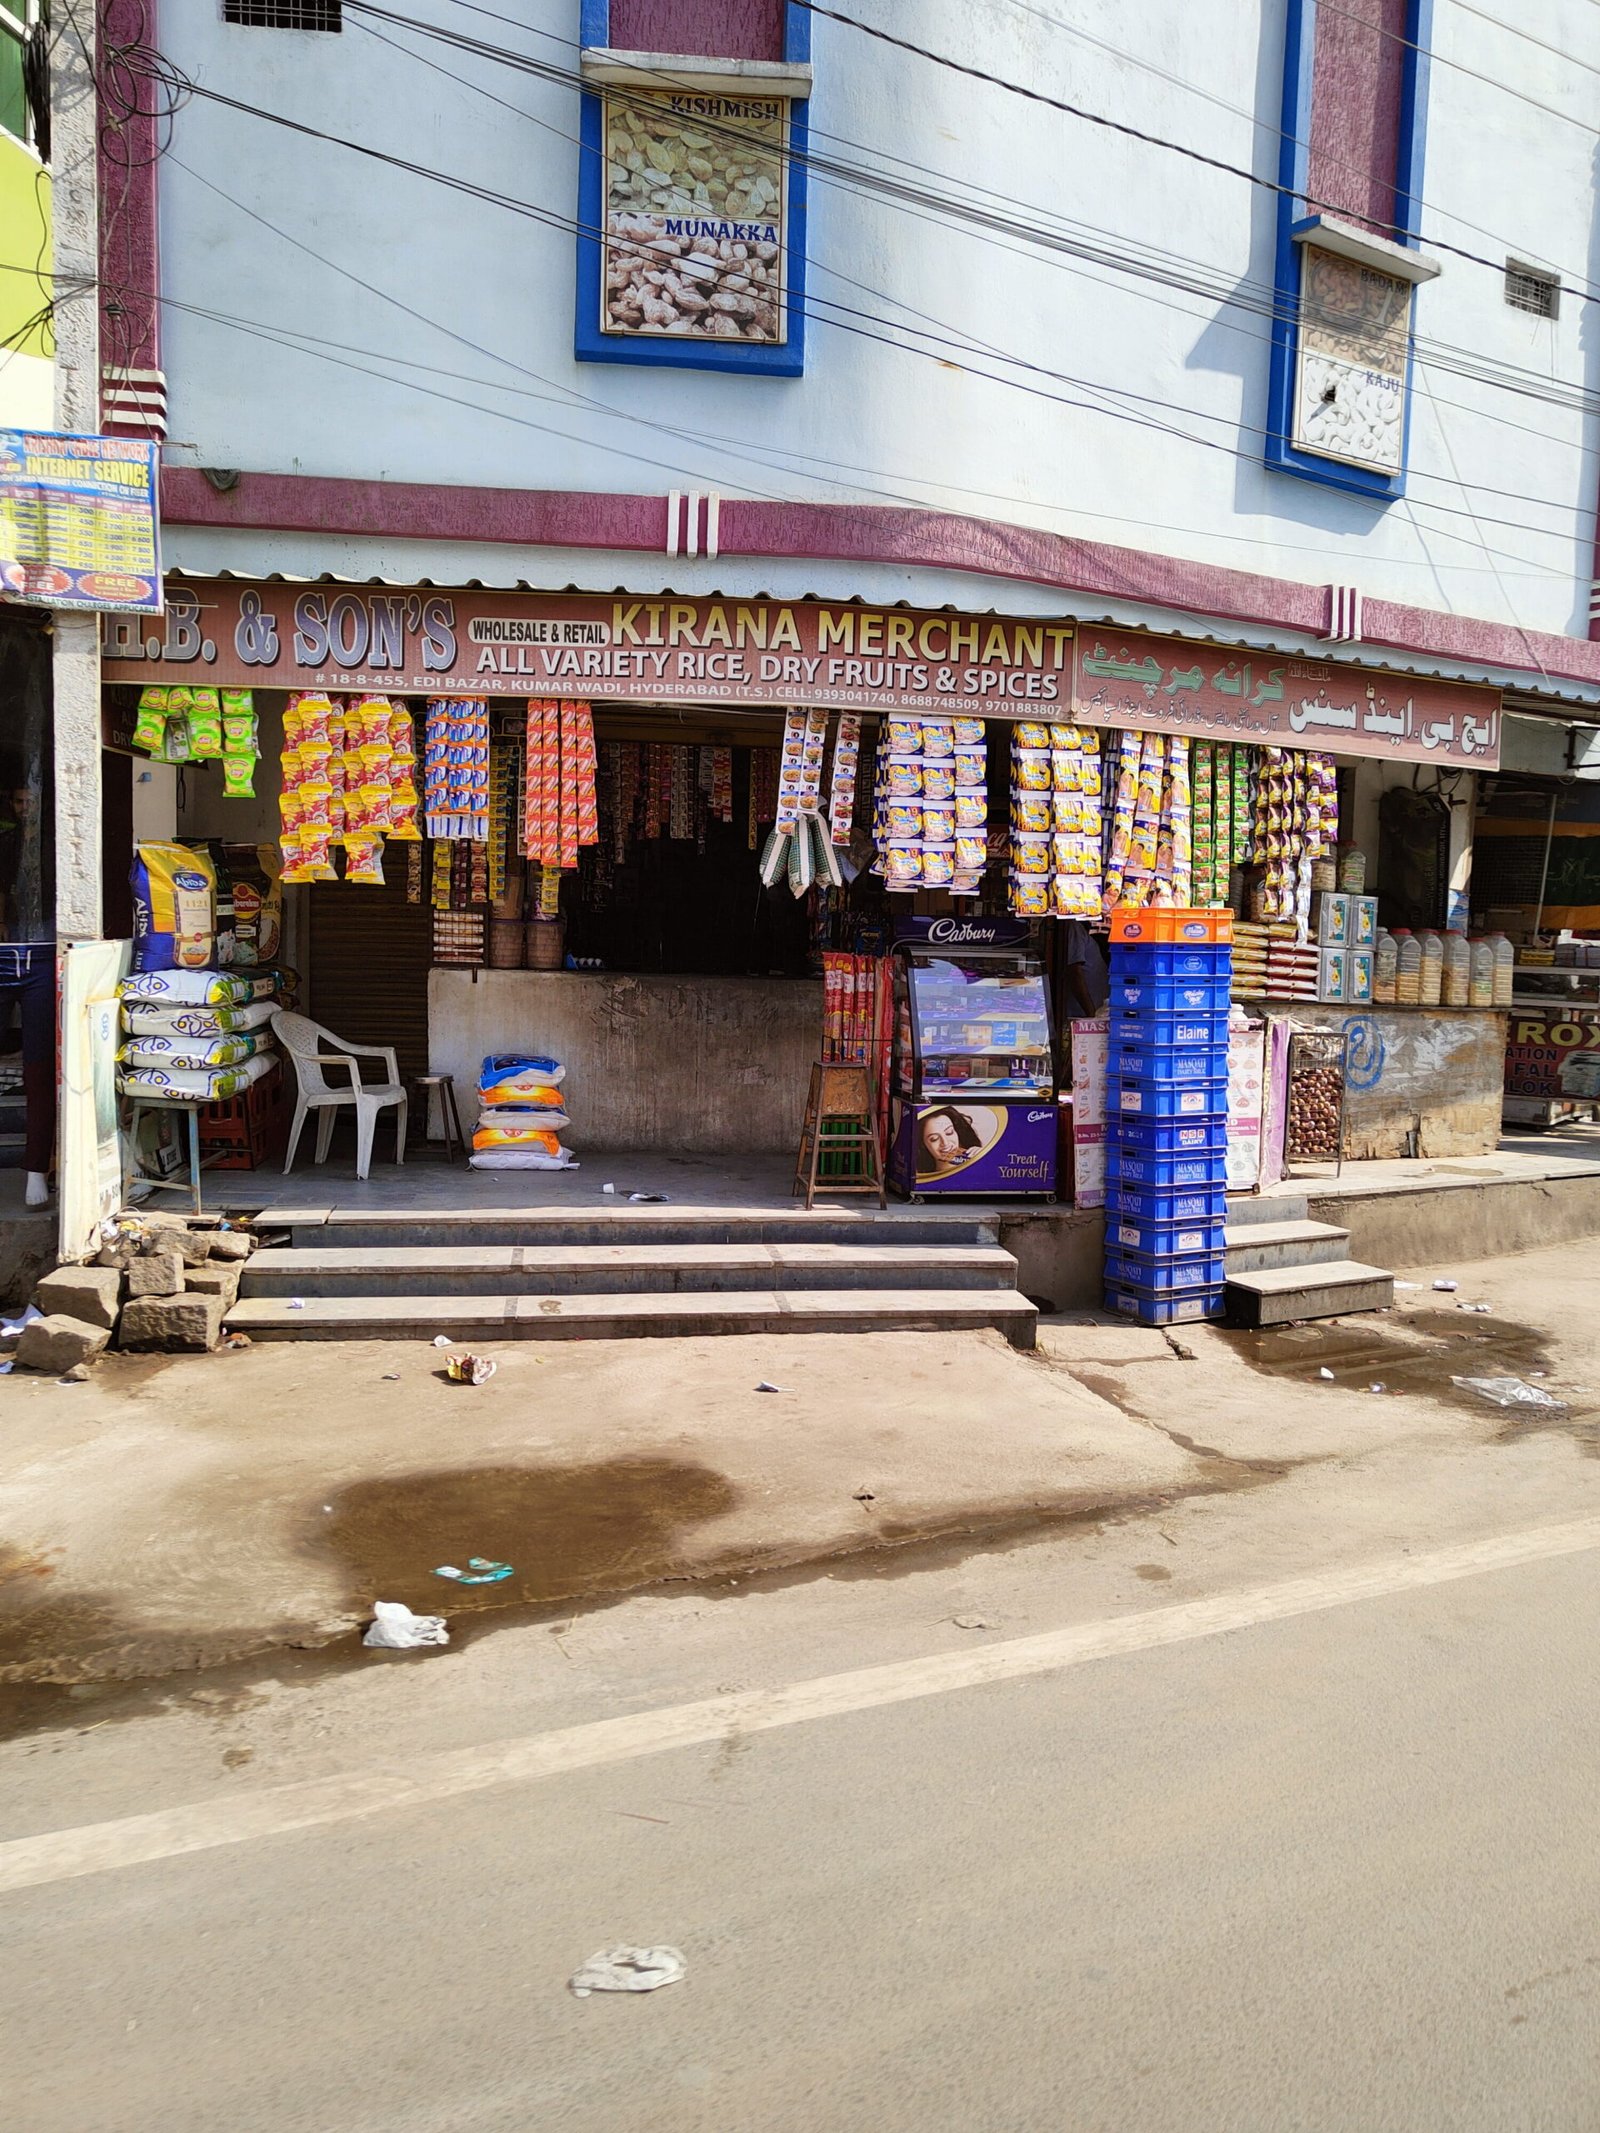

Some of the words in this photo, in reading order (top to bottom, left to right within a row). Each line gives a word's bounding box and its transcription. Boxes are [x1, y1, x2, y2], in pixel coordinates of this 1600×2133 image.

[670, 94, 780, 120] KISHMISH
[665, 218, 777, 242] MUNAKKA
[1359, 268, 1407, 296] BADAM
[1365, 370, 1400, 393] KAJU
[26, 456, 92, 480] INTERNET
[94, 460, 150, 488] SERVICE
[94, 575, 138, 588] FREE
[234, 588, 280, 664] &
[293, 591, 457, 673] SON'S
[472, 619, 548, 643] WHOLESALE
[550, 623, 560, 643] &
[563, 624, 606, 645] RETAIL
[611, 602, 803, 653] KIRANA
[817, 609, 1074, 670] MERCHANT
[476, 646, 534, 675] ALL
[540, 649, 671, 679] VARIETY
[677, 653, 752, 684] RICE,
[760, 654, 821, 684] DRY
[828, 658, 929, 691] FRUITS
[935, 666, 957, 693] &
[963, 668, 1059, 700] SPICES
[413, 676, 444, 688] EDI
[446, 678, 507, 693] BAZAR,
[511, 679, 573, 693] KUMAR
[575, 682, 626, 695] WADI,
[629, 683, 732, 698] HYDERABAD
[735, 685, 774, 699] (T.S.)
[814, 689, 898, 706] 9393041740,
[900, 694, 983, 712] 8688748509,
[986, 700, 1062, 717] 9701883807
[928, 917, 996, 944] Cadbury
[1078, 1021, 1110, 1032] MAS
[1176, 1024, 1209, 1040] Elaine
[1508, 1021, 1600, 1049] ROX
[1505, 1046, 1558, 1062] ATION
[1008, 1153, 1037, 1165] Treat
